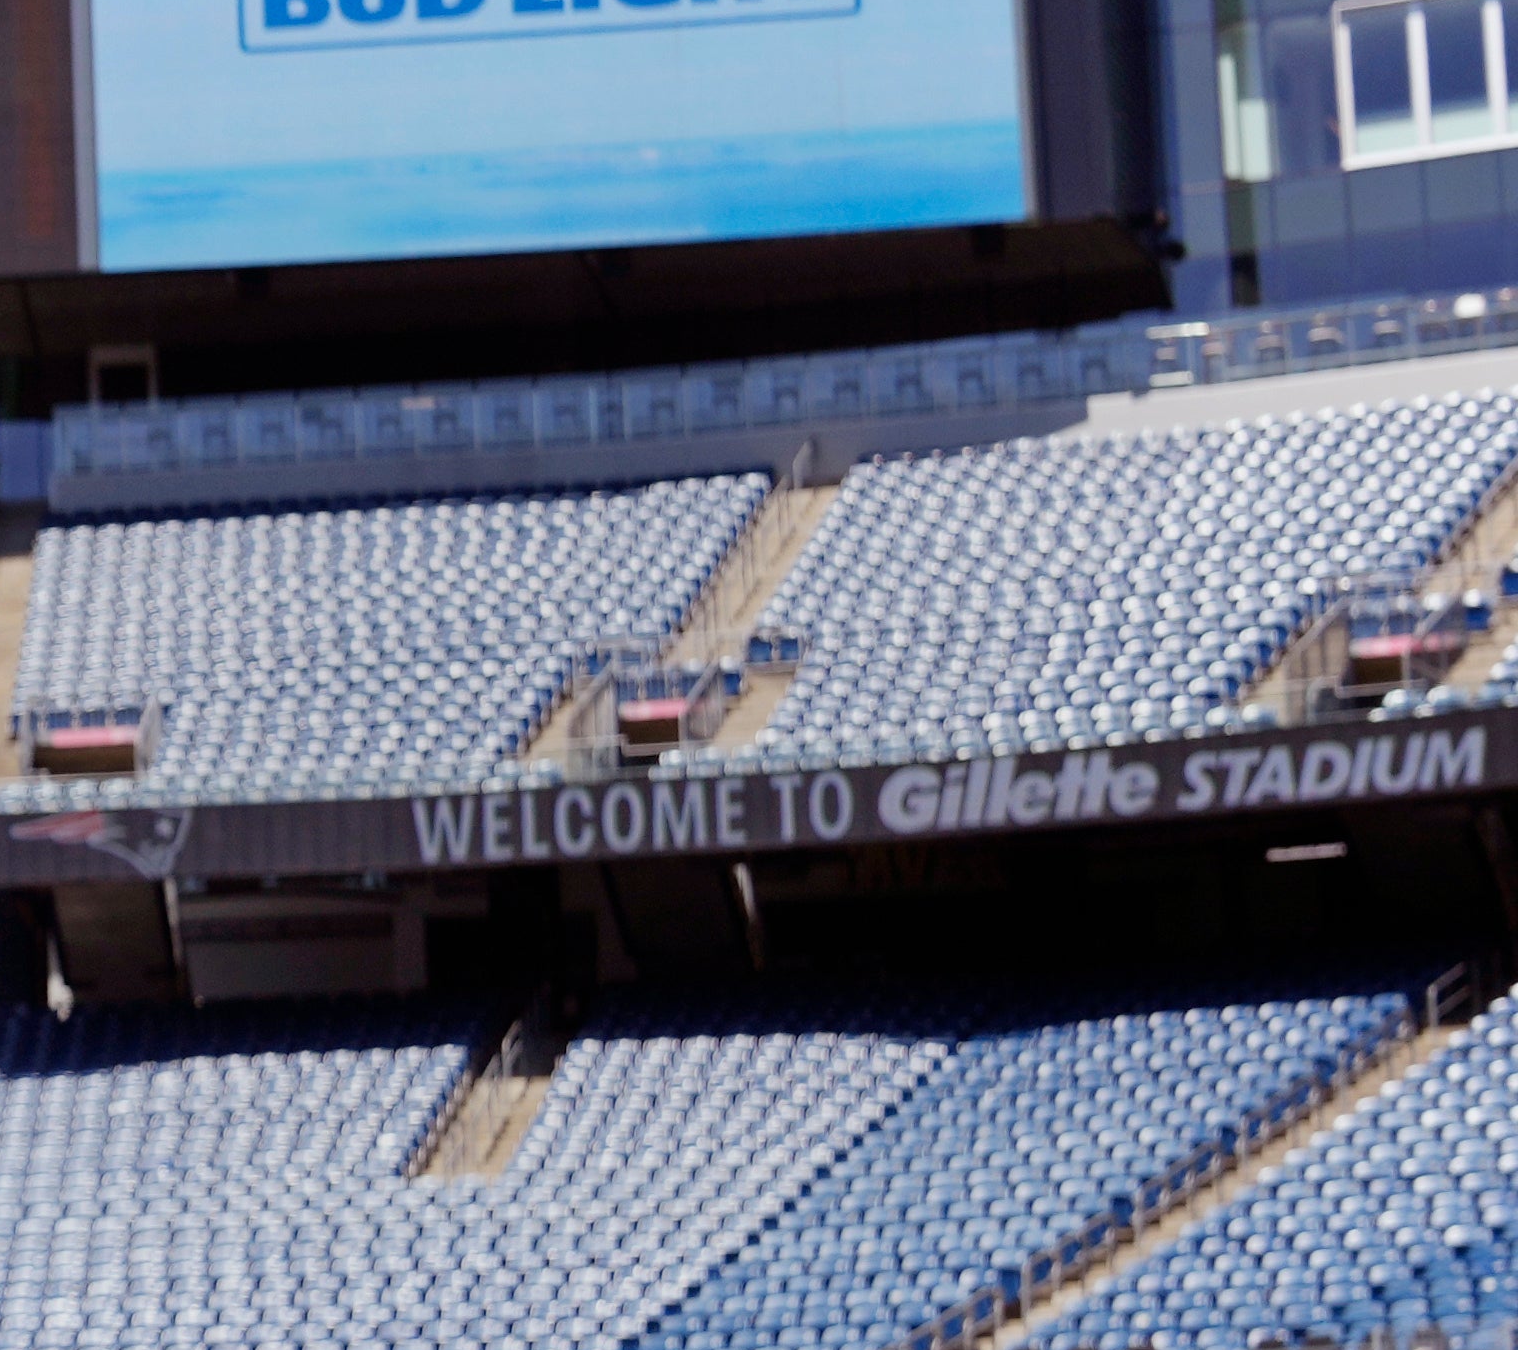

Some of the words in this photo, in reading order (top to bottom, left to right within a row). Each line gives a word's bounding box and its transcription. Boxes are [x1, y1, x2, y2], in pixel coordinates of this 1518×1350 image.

[412, 776, 747, 865] WELCOME
[772, 772, 854, 843] TO
[877, 751, 1159, 834] Gillette
[1177, 726, 1487, 813] STADIUM
